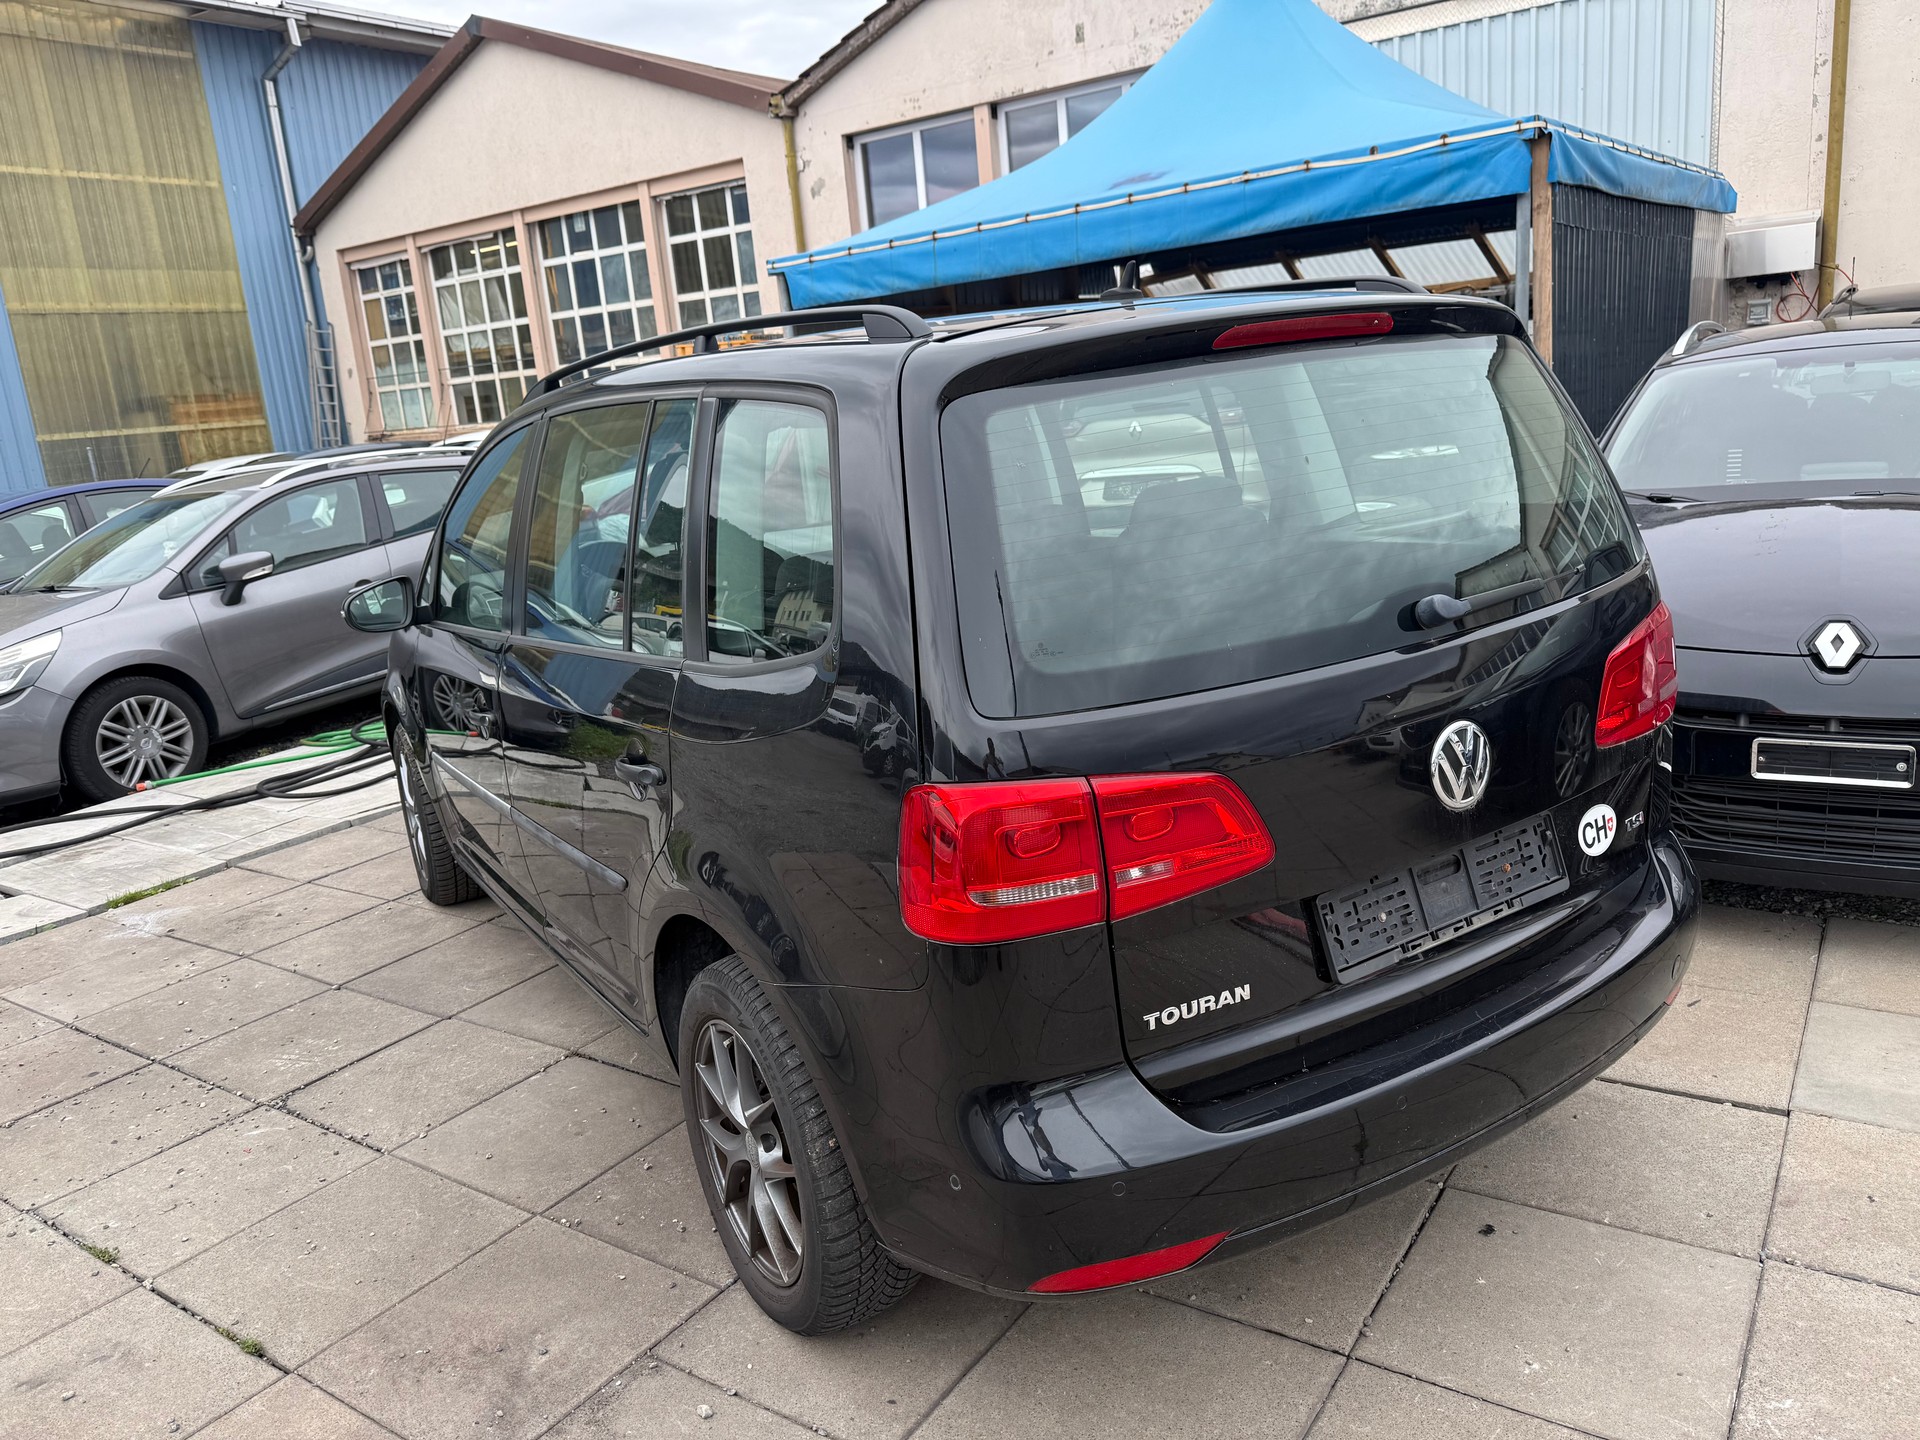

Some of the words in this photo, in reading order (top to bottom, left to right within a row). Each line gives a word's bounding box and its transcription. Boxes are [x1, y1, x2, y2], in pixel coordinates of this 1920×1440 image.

[1582, 813, 1608, 849] CH
[1625, 810, 1645, 832] TSI
[1143, 983, 1251, 1031] TOURAN
